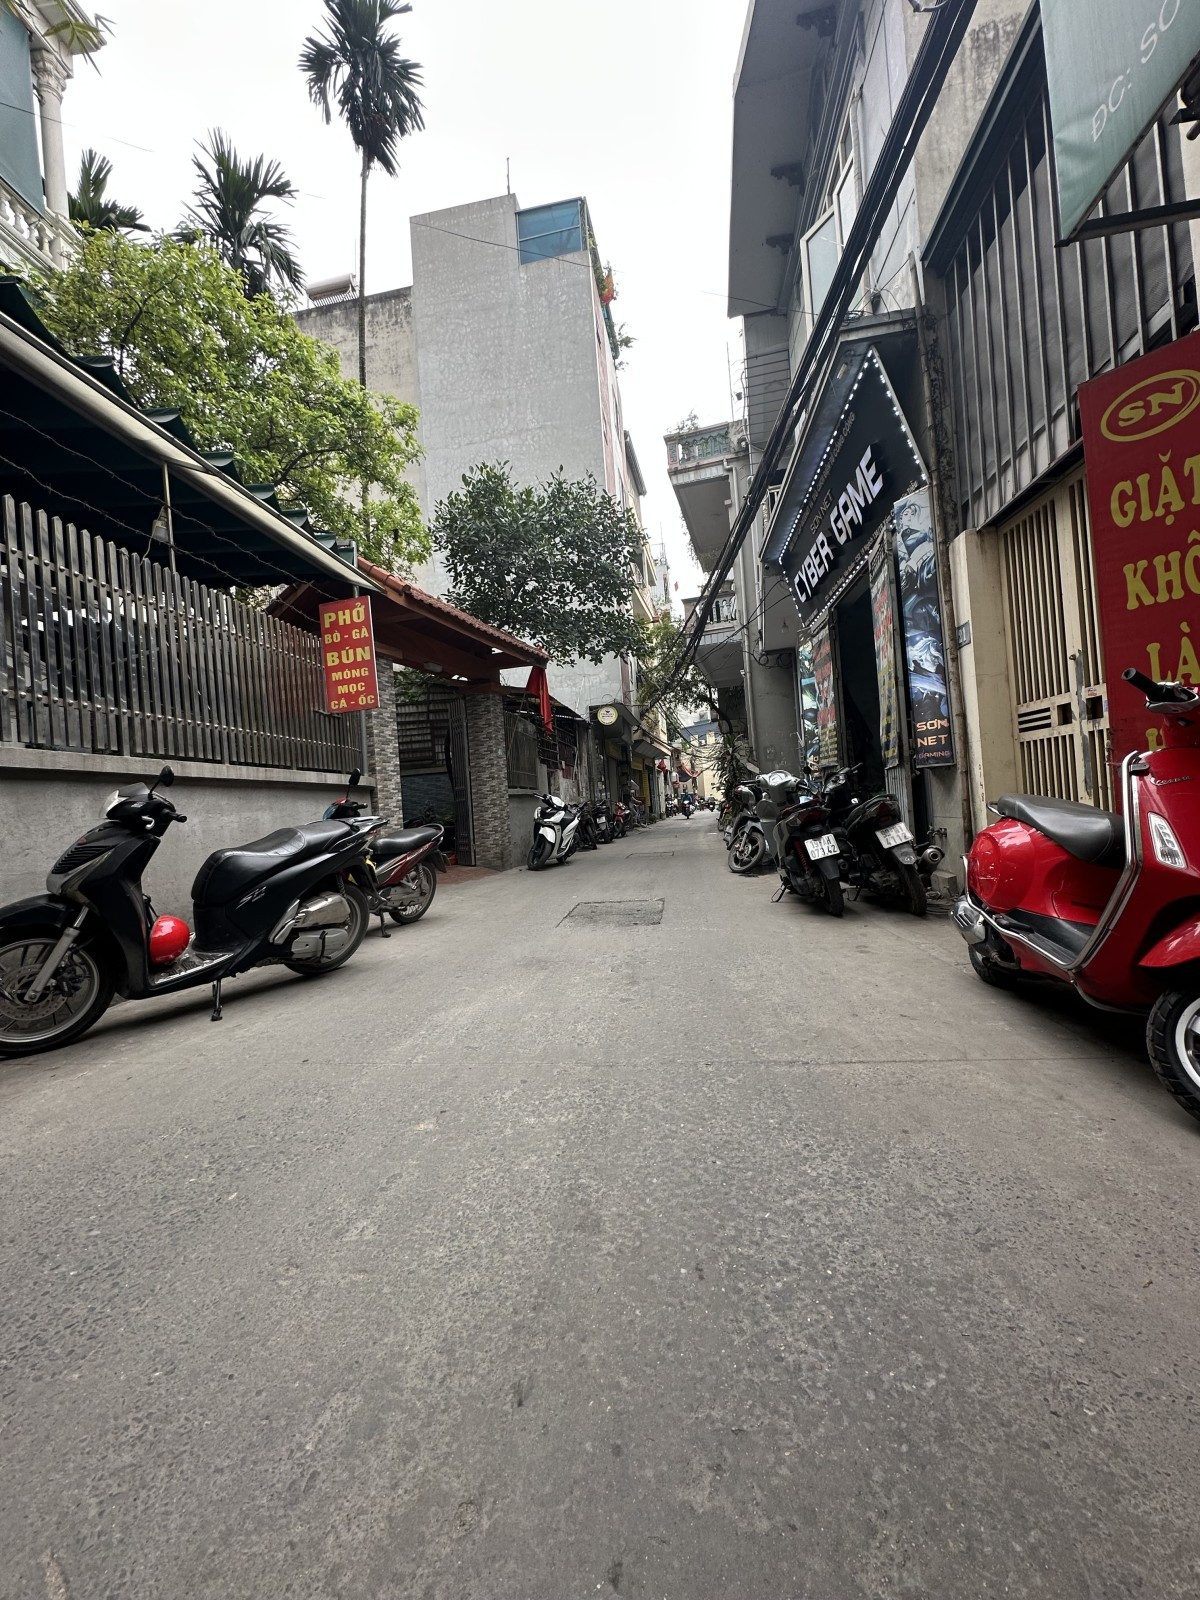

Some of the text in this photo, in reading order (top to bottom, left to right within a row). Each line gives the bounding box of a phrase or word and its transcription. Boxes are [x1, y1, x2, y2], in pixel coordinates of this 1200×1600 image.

[1118, 381, 1186, 427] SN
[794, 531, 835, 603] CYBER
[830, 445, 884, 546] GAME
[323, 602, 365, 628] PHỞ
[324, 630, 341, 644] BÒ
[352, 626, 369, 640] GÀ
[326, 646, 371, 667] BÚN
[1146, 621, 1200, 686] LÀ
[331, 667, 369, 682] MÓNG
[337, 682, 366, 694] MỌC
[358, 692, 375, 706] ỐC
[917, 734, 949, 748] NET
[918, 751, 950, 759] GAMING
